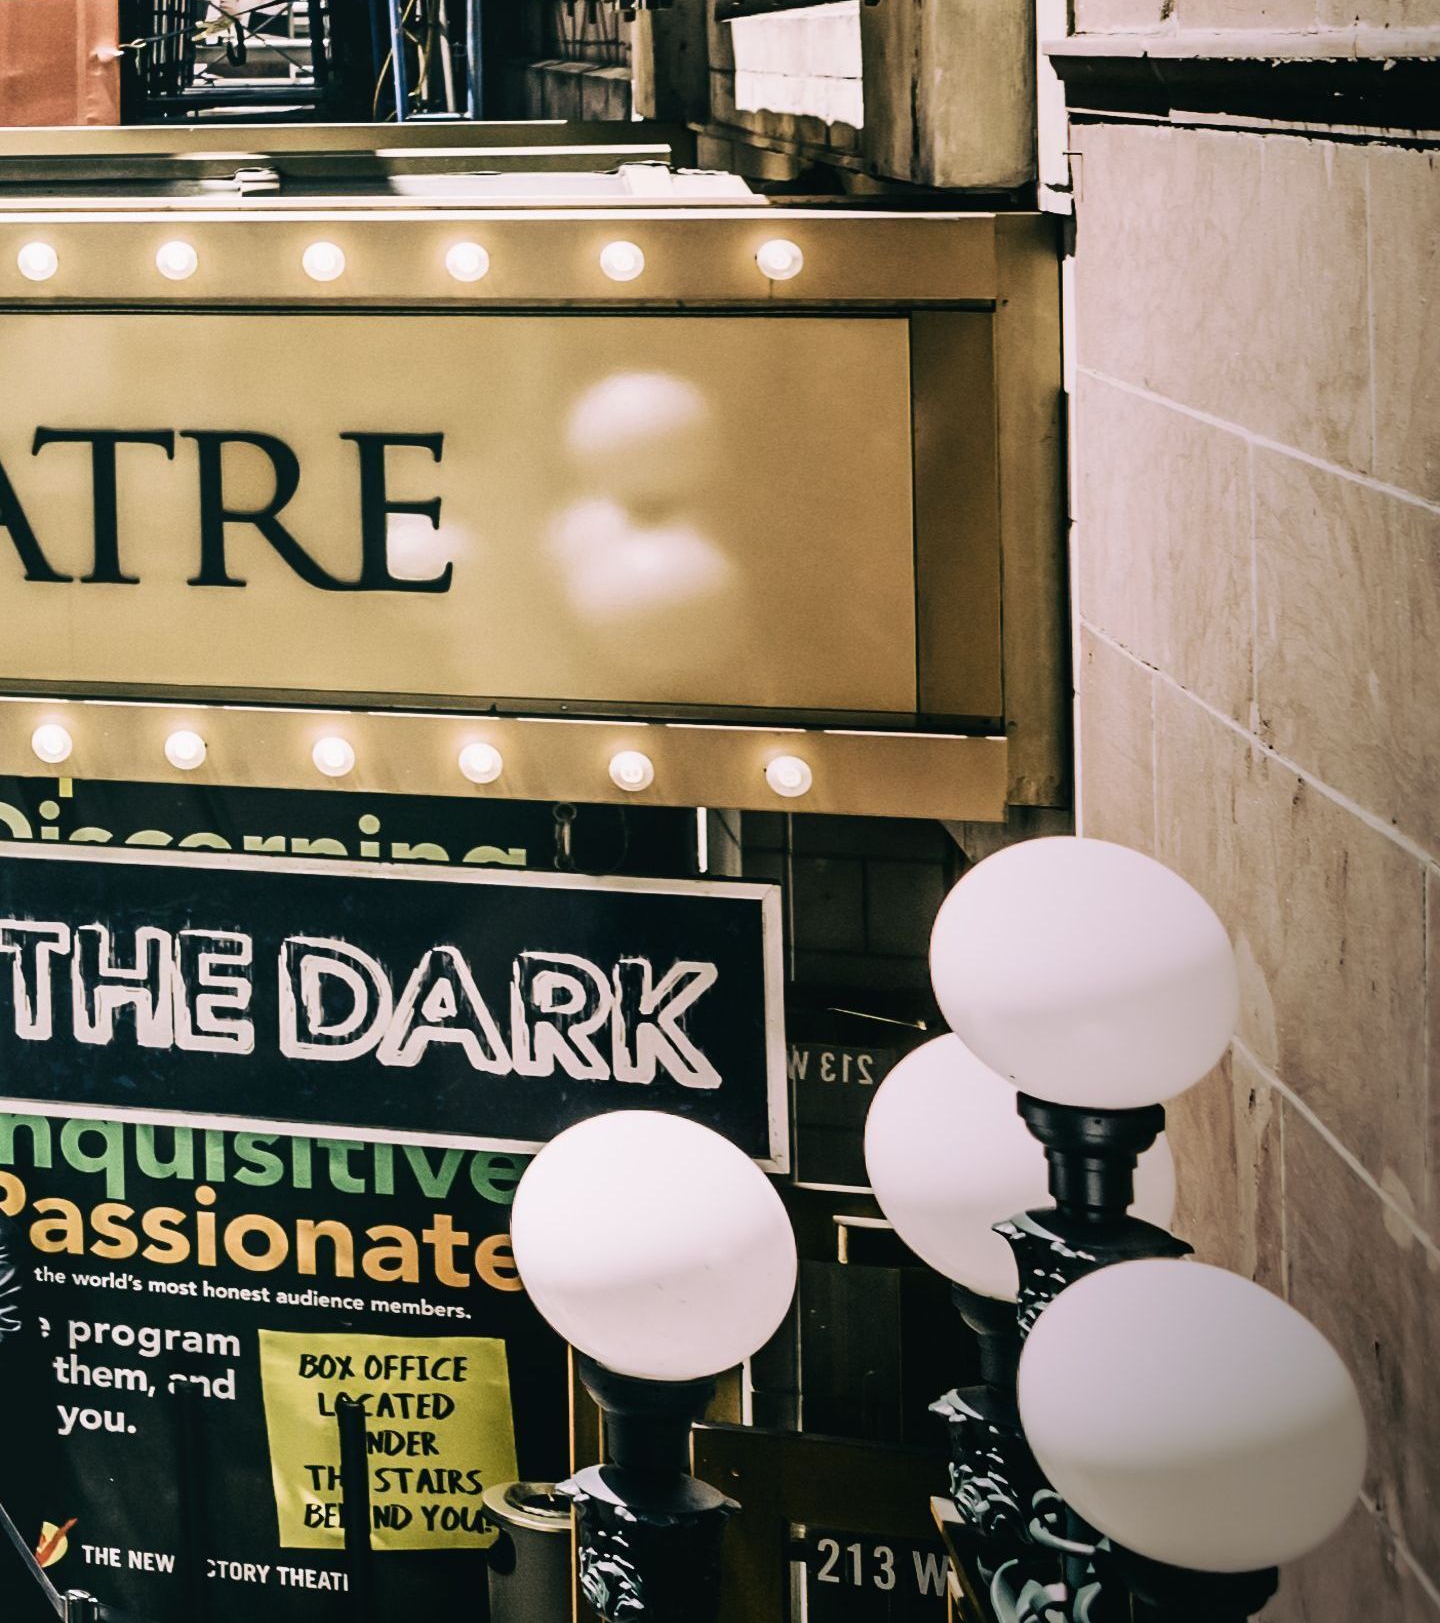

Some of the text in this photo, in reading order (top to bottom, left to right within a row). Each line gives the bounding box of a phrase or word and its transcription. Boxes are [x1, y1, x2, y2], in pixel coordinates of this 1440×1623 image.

[279, 933, 725, 1091] DARK
[34, 1267, 472, 1320] the world's most honest audience members.
[68, 1318, 242, 1359] program
[52, 1354, 156, 1399] them,
[298, 1354, 470, 1383] BOX OFFICE
[57, 1402, 137, 1436] you.
[374, 1467, 484, 1497] STAIRS
[81, 1545, 175, 1574] THE NEW
[817, 1538, 950, 1597] 213 W
